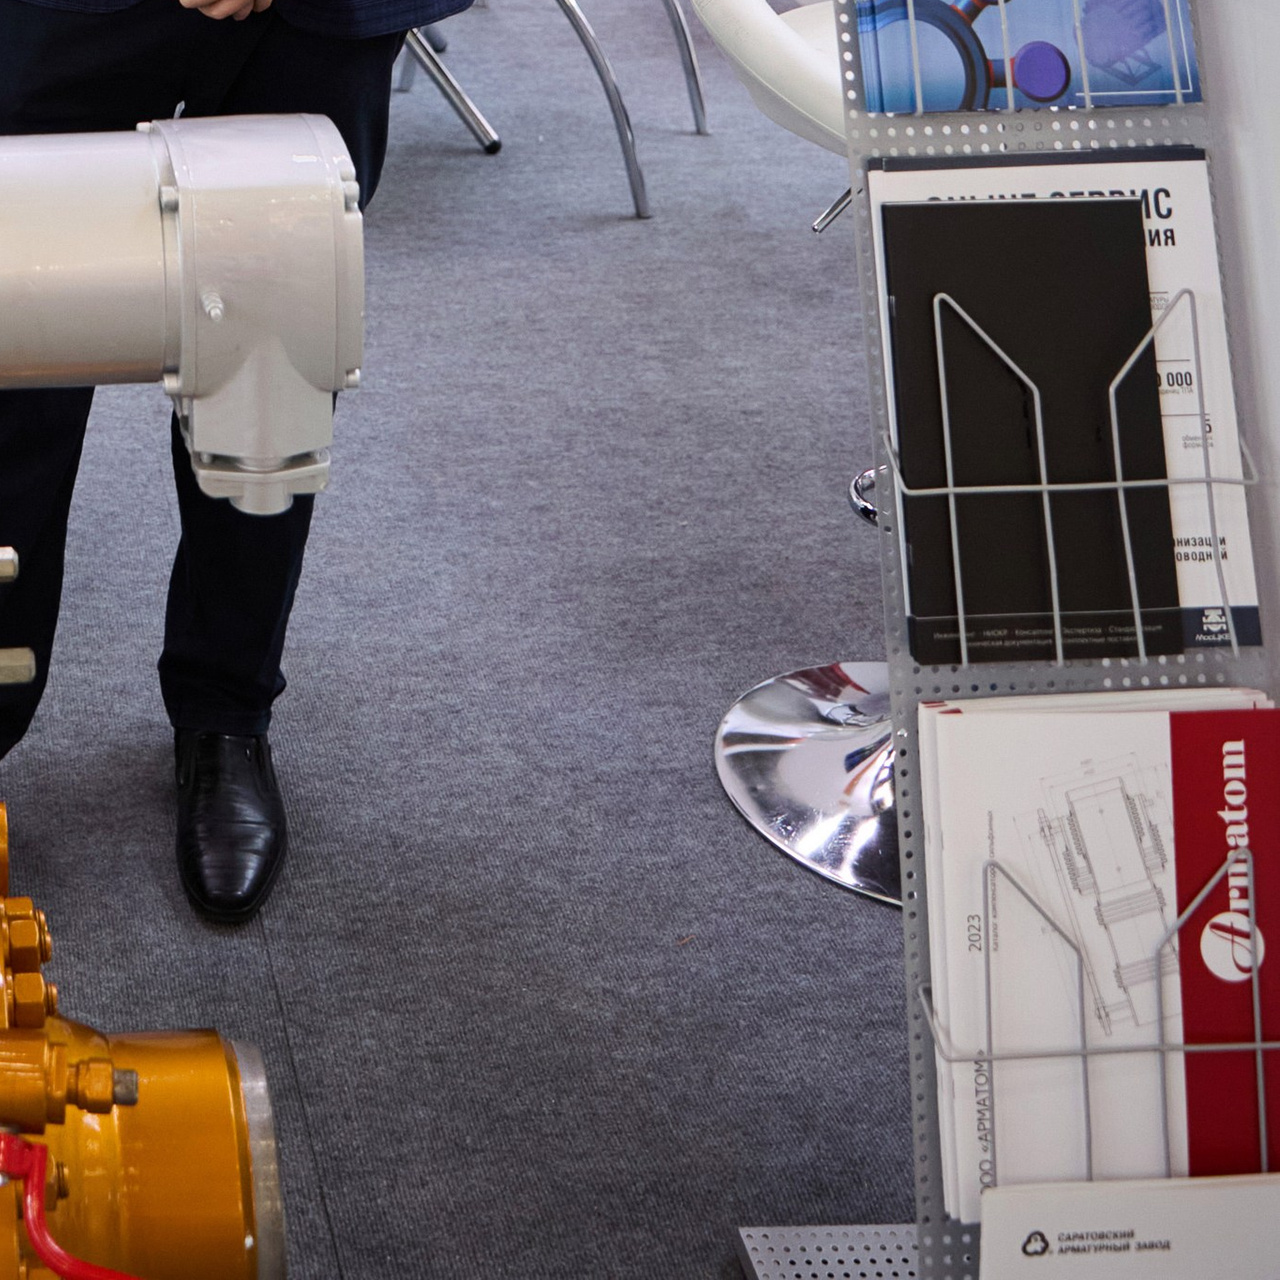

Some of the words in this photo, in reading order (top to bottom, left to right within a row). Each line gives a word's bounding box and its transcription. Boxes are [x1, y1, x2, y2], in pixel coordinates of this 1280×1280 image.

[967, 914, 983, 952] 2023
[1057, 1229, 1135, 1242] САРАТОВСКИЙ
[1057, 1242, 1130, 1255] АРМАТУРНЫЙ
[1135, 1240, 1172, 1252] ЗАВОД
